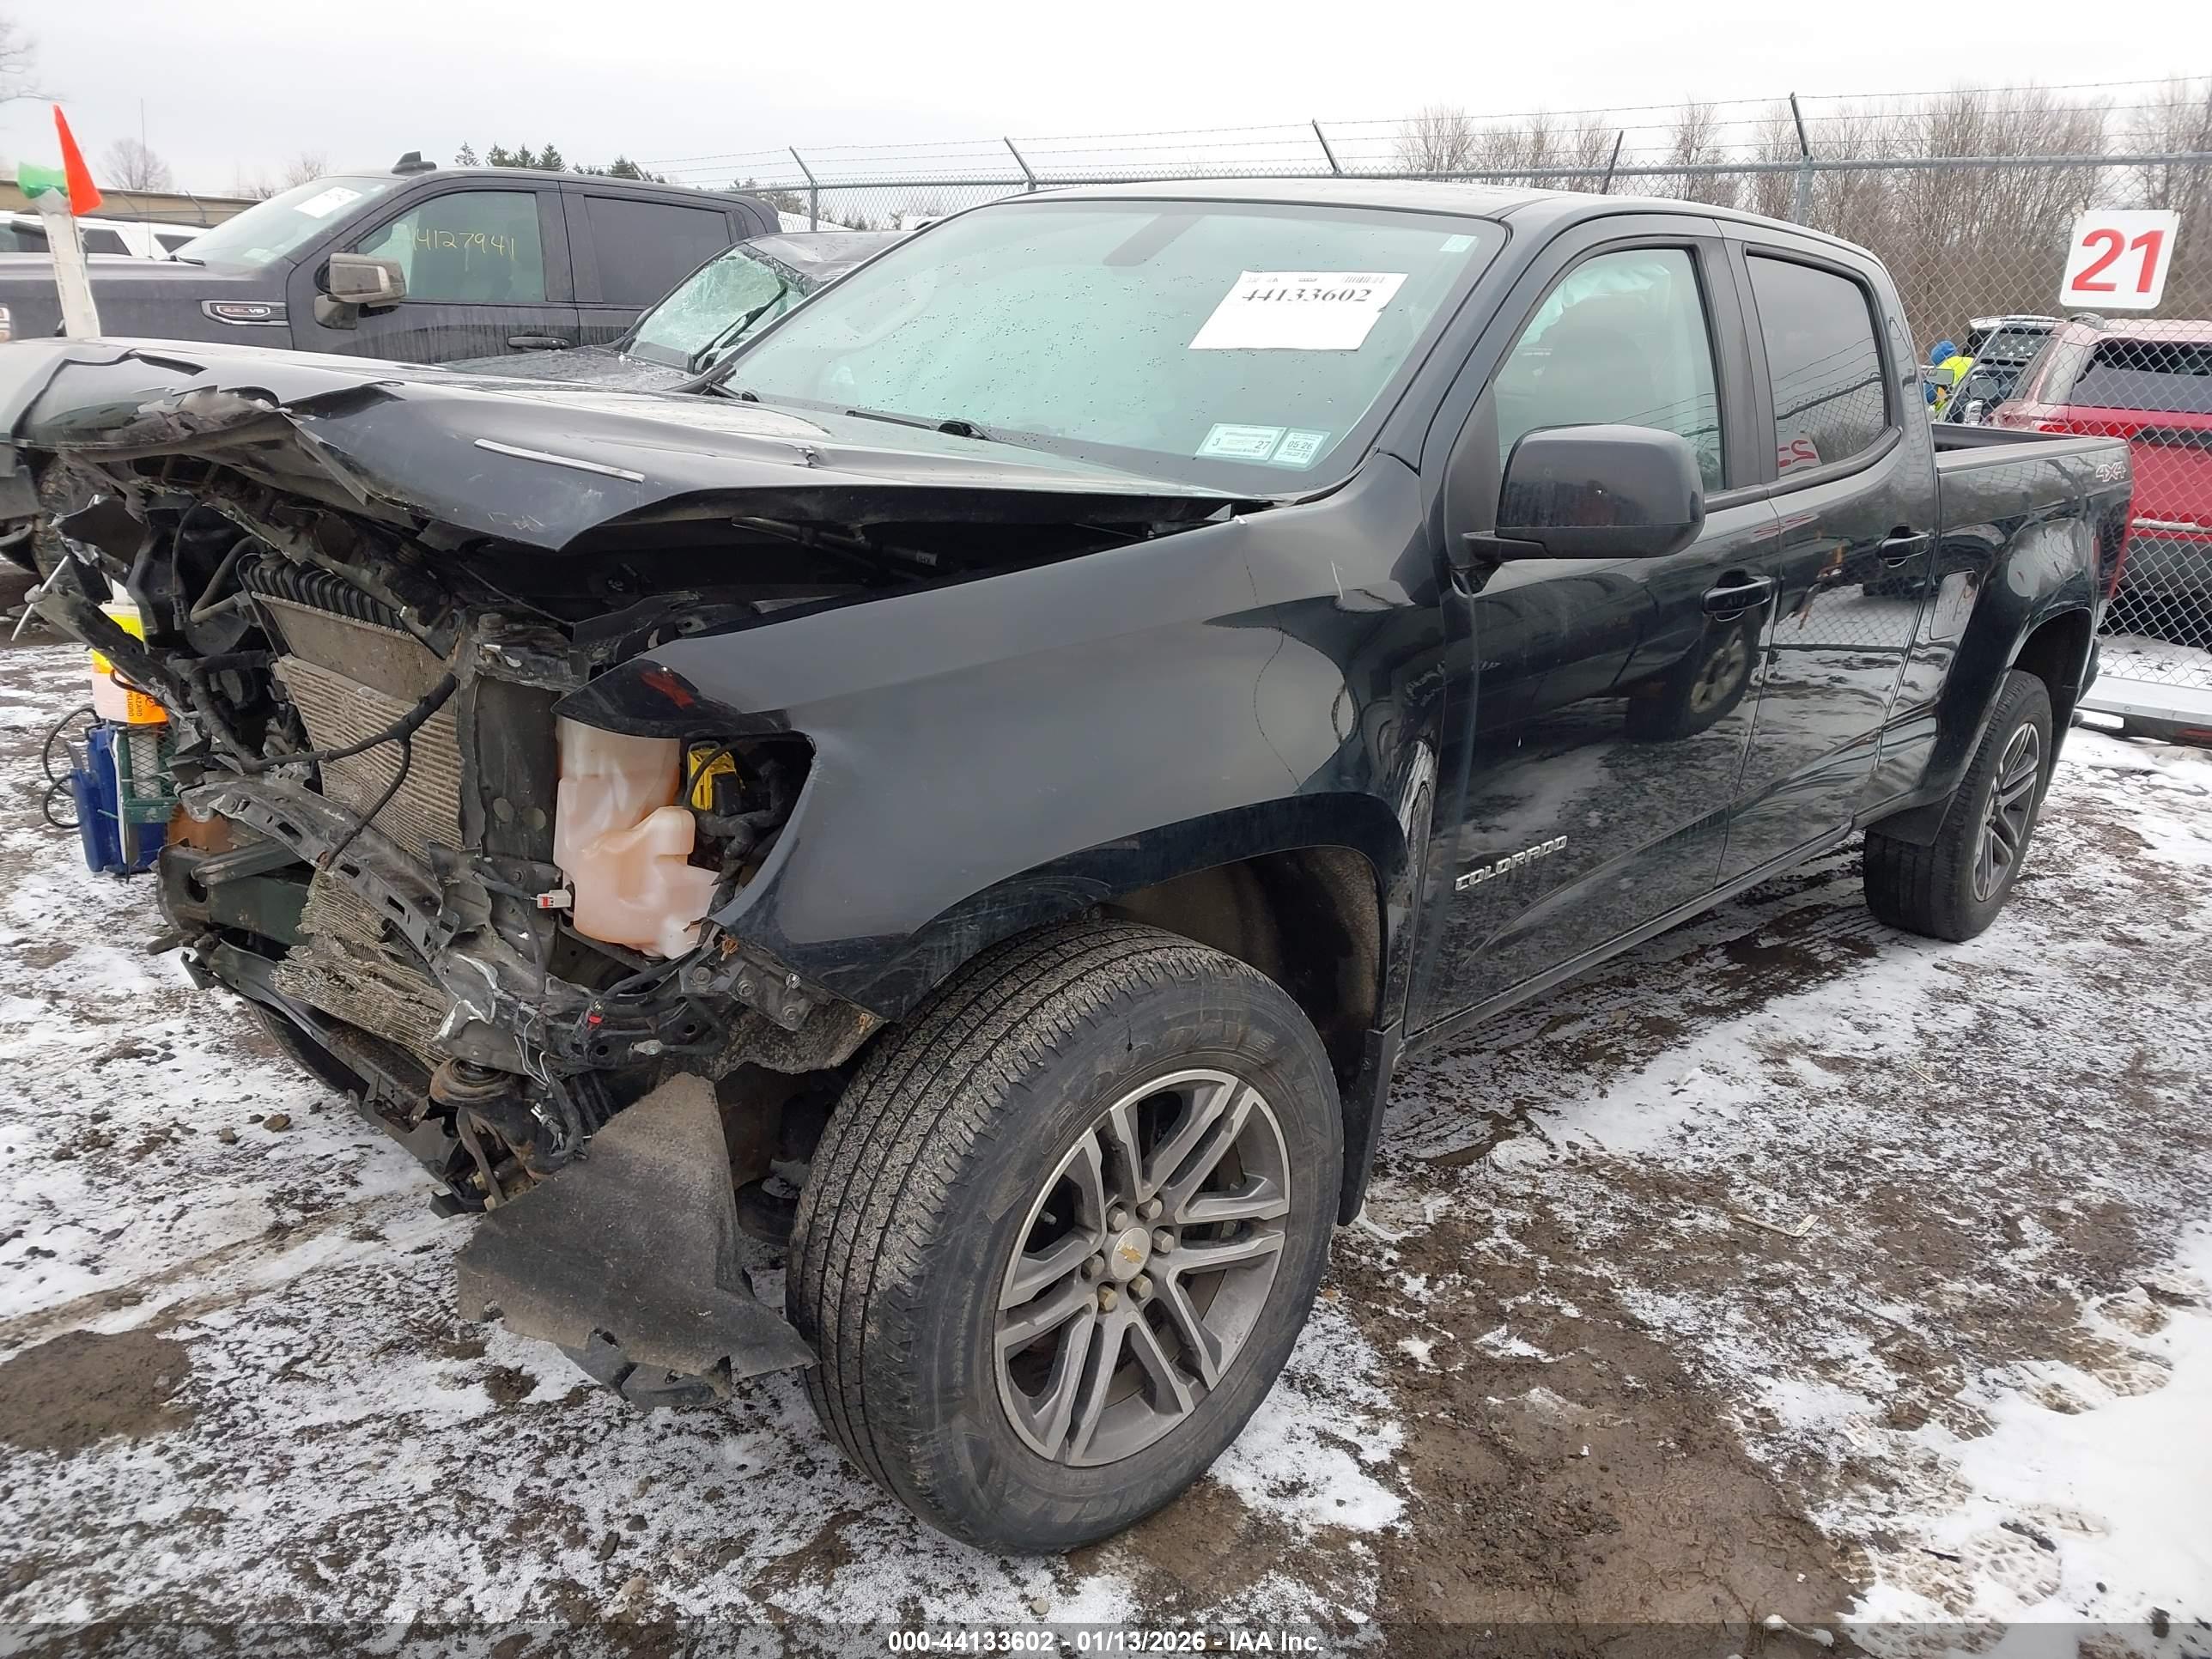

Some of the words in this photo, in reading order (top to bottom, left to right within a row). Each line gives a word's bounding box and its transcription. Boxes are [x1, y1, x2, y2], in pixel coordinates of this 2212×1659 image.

[2070, 228, 2166, 294] 21
[1242, 288, 1373, 302] 44133602
[1254, 439, 1272, 451] 27
[1455, 835, 1569, 891] COLORADO
